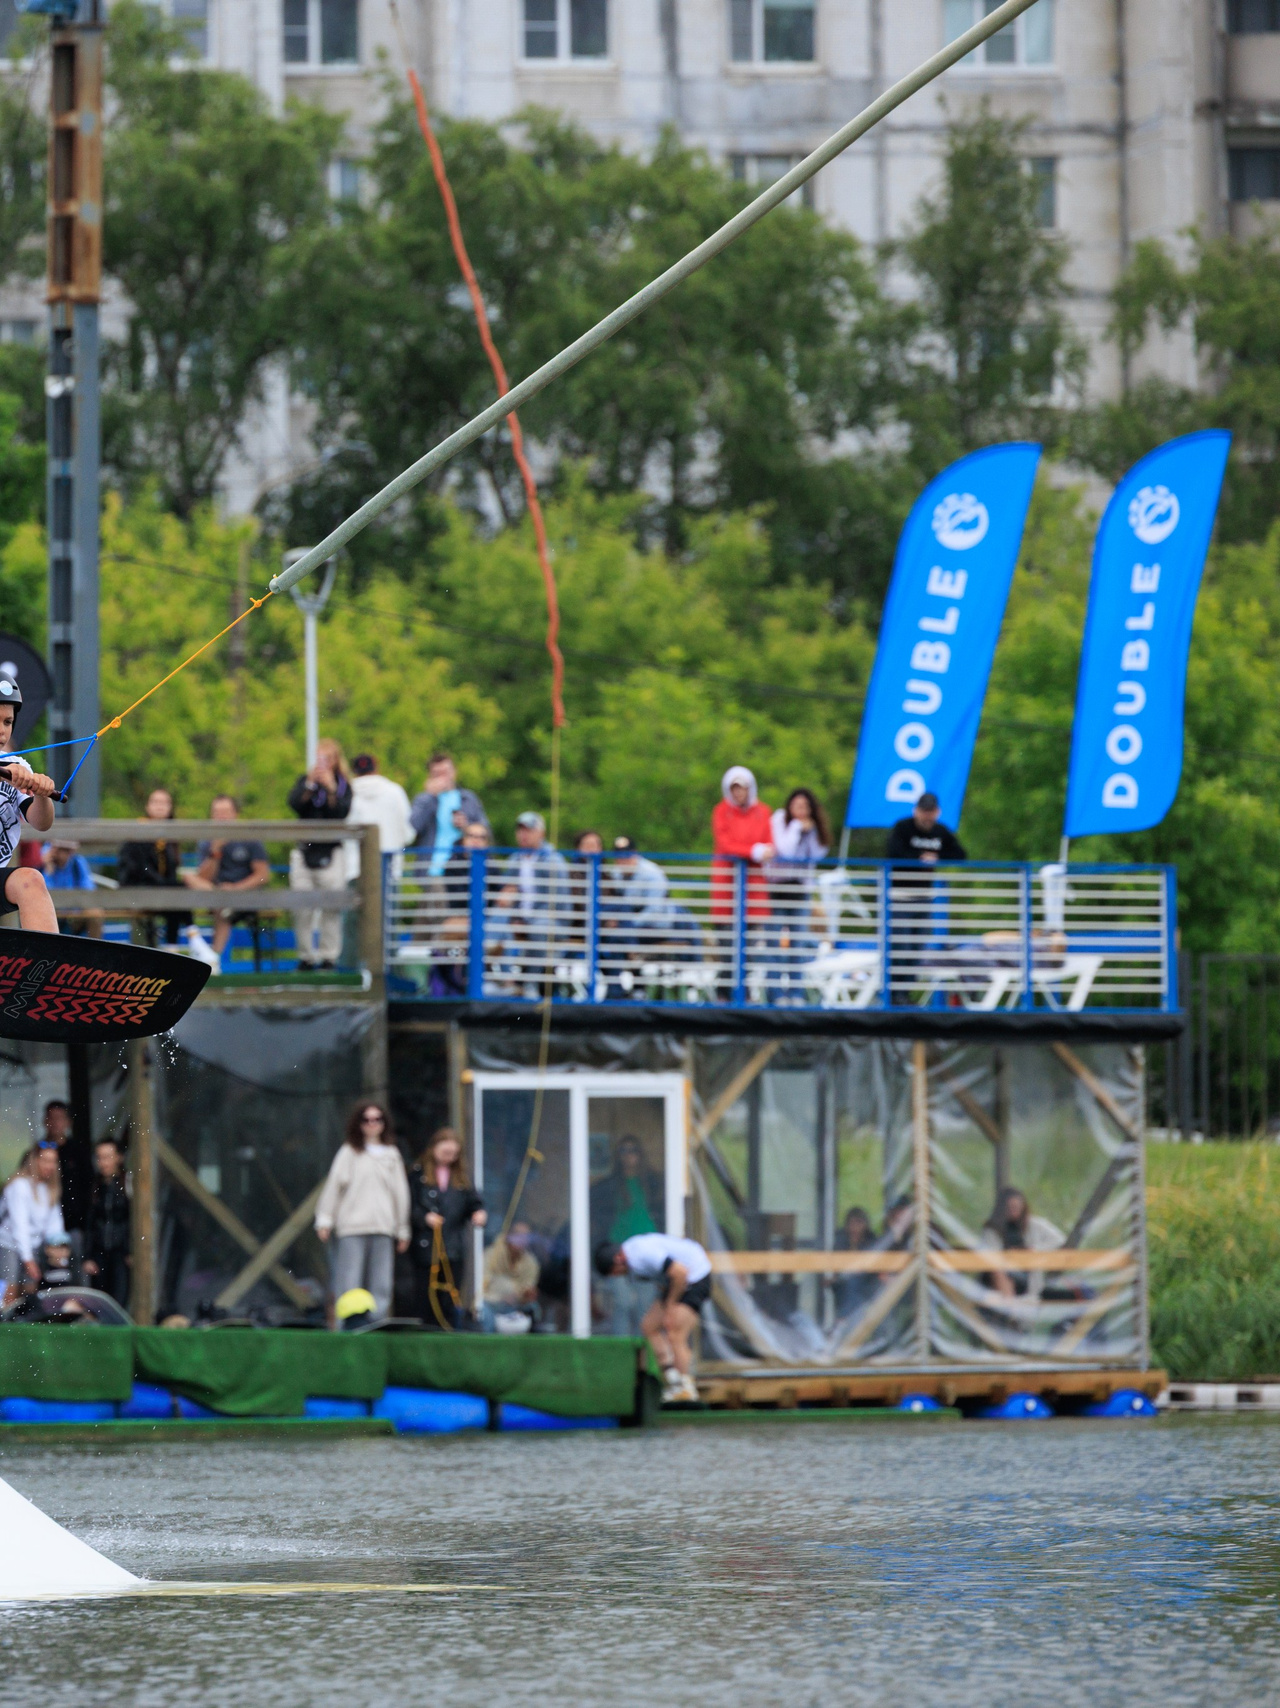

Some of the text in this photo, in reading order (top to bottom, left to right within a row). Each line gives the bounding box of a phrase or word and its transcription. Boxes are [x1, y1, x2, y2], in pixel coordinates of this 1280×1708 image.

[886, 566, 968, 804] DOUBLE
[1103, 563, 1161, 809] DOUBLE
[4, 960, 56, 1019] MIR
[26, 963, 77, 1020] MIR
[44, 966, 94, 1022] MIR
[61, 969, 110, 1024] MIR
[78, 972, 126, 1024] MIR
[96, 975, 142, 1024] MIR
[113, 977, 157, 1024] MIR
[129, 978, 172, 1024] MIR
